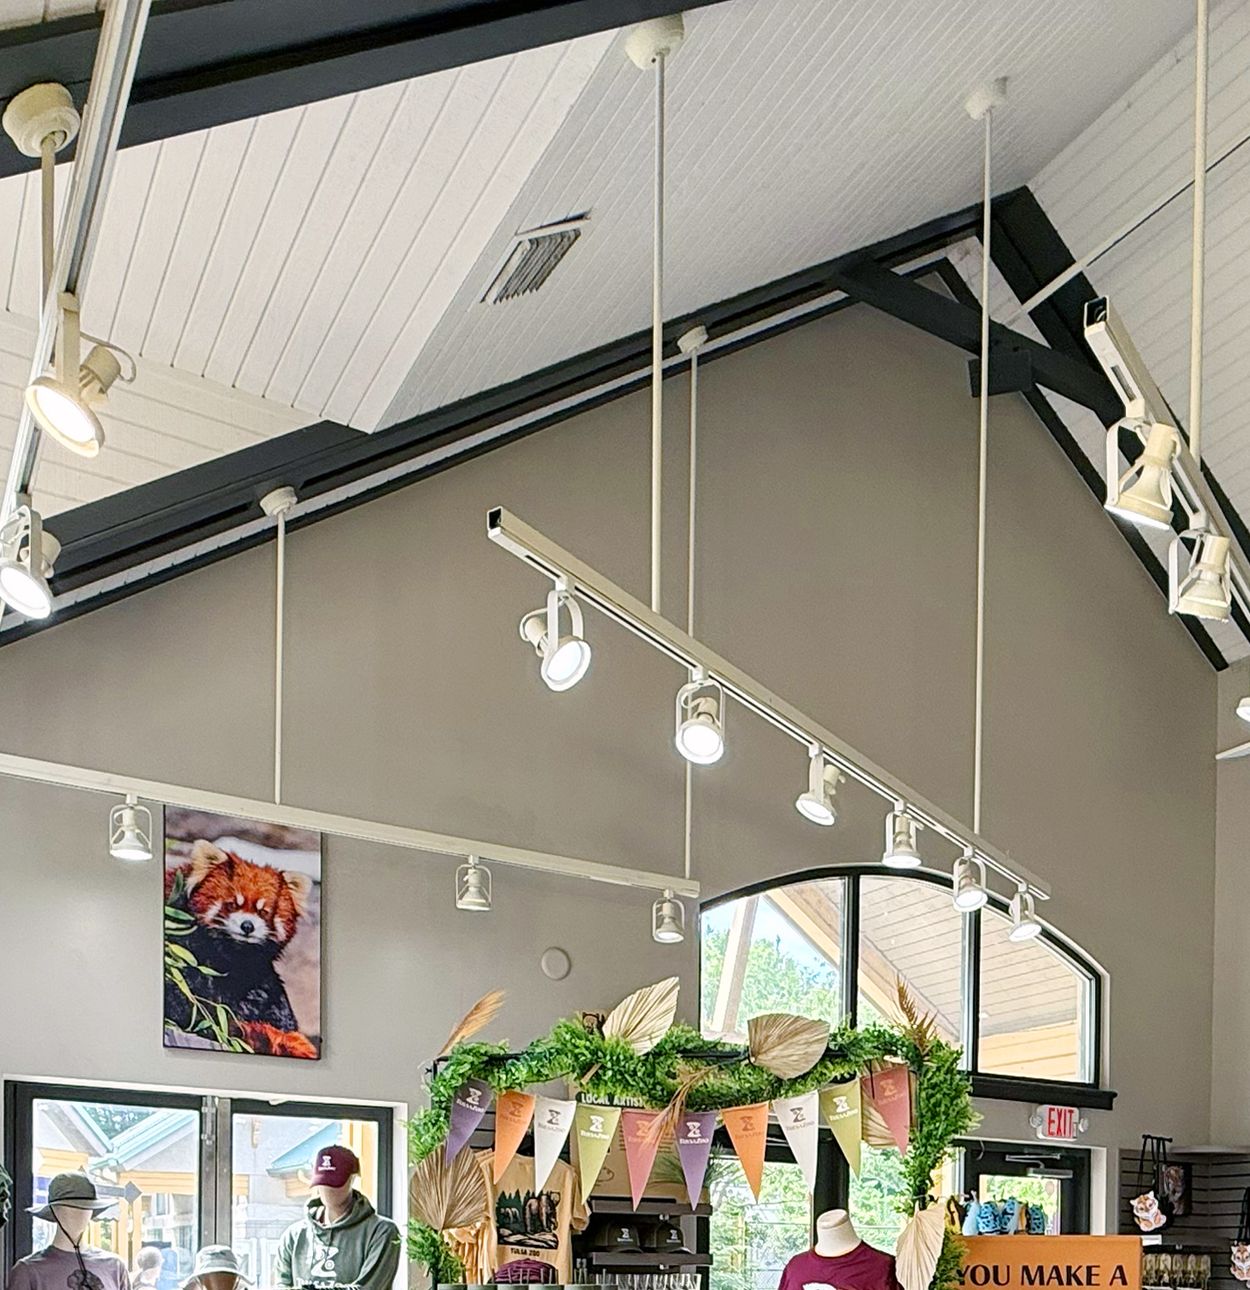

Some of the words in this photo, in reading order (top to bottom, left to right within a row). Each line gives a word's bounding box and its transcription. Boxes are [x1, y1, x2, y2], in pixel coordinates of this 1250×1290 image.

[581, 1092, 610, 1105] LOCAL
[1048, 1107, 1074, 1138] EXIT
[956, 1264, 1010, 1287] YOU
[1021, 1264, 1101, 1286] MAKE
[1109, 1264, 1128, 1286] A
